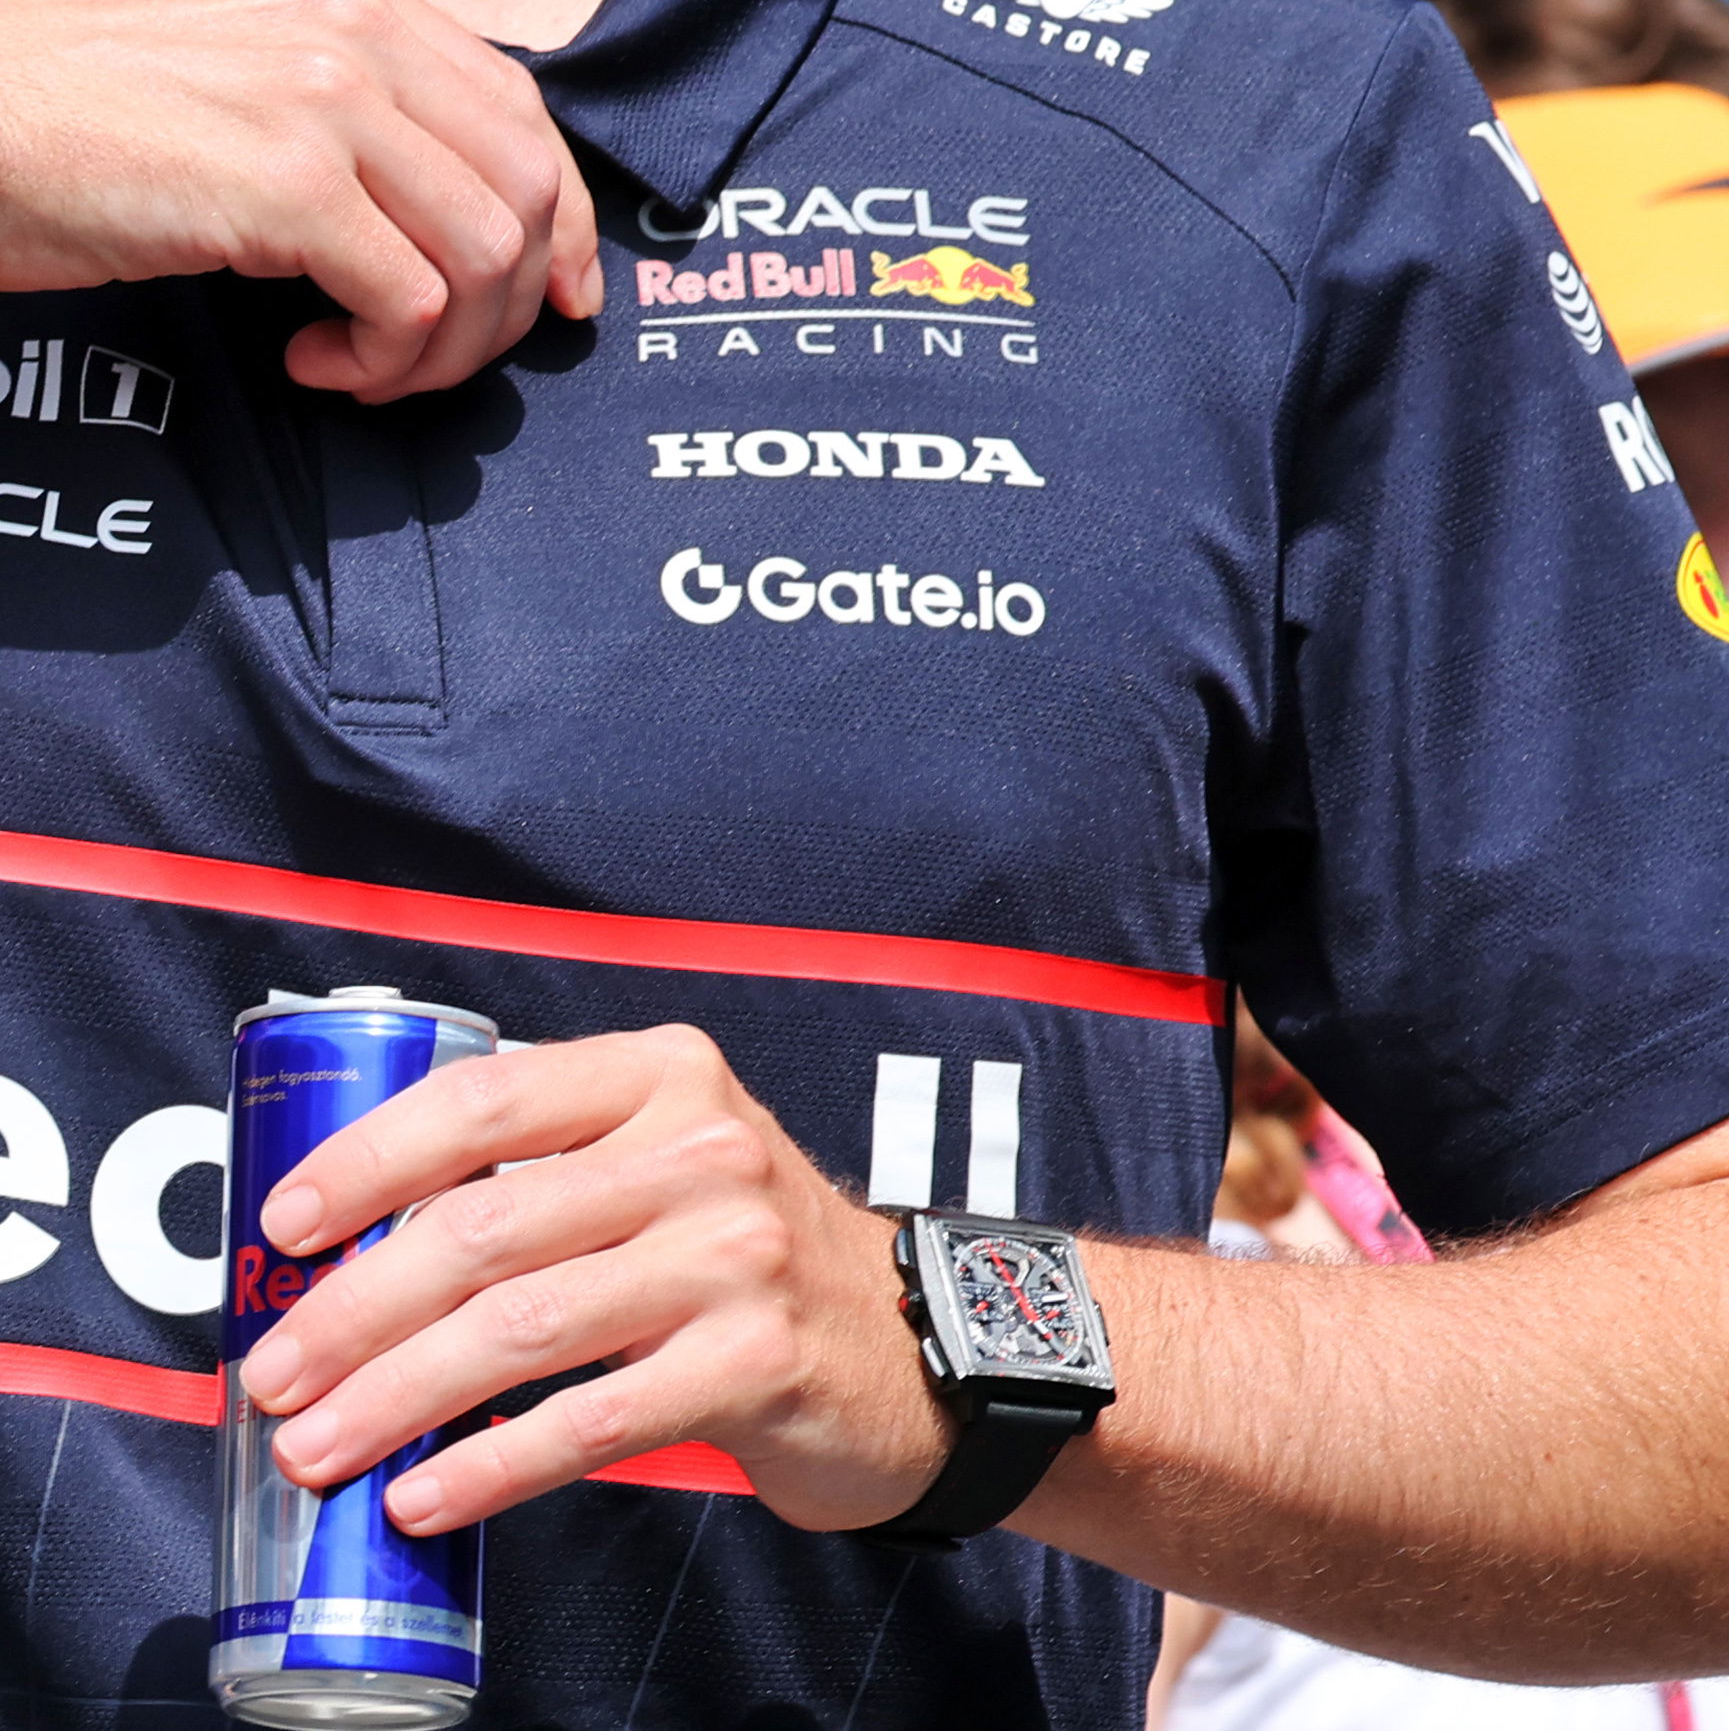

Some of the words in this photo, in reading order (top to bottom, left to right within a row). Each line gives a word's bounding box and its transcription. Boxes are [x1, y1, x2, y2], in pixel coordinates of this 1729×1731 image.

[635, 251, 747, 307] Red
[749, 247, 857, 299] Bull
[638, 324, 1039, 364] RACING
[647, 428, 1046, 488] HONDA
[747, 555, 1047, 637] Gate.io
[234, 1236, 359, 1317] Re
